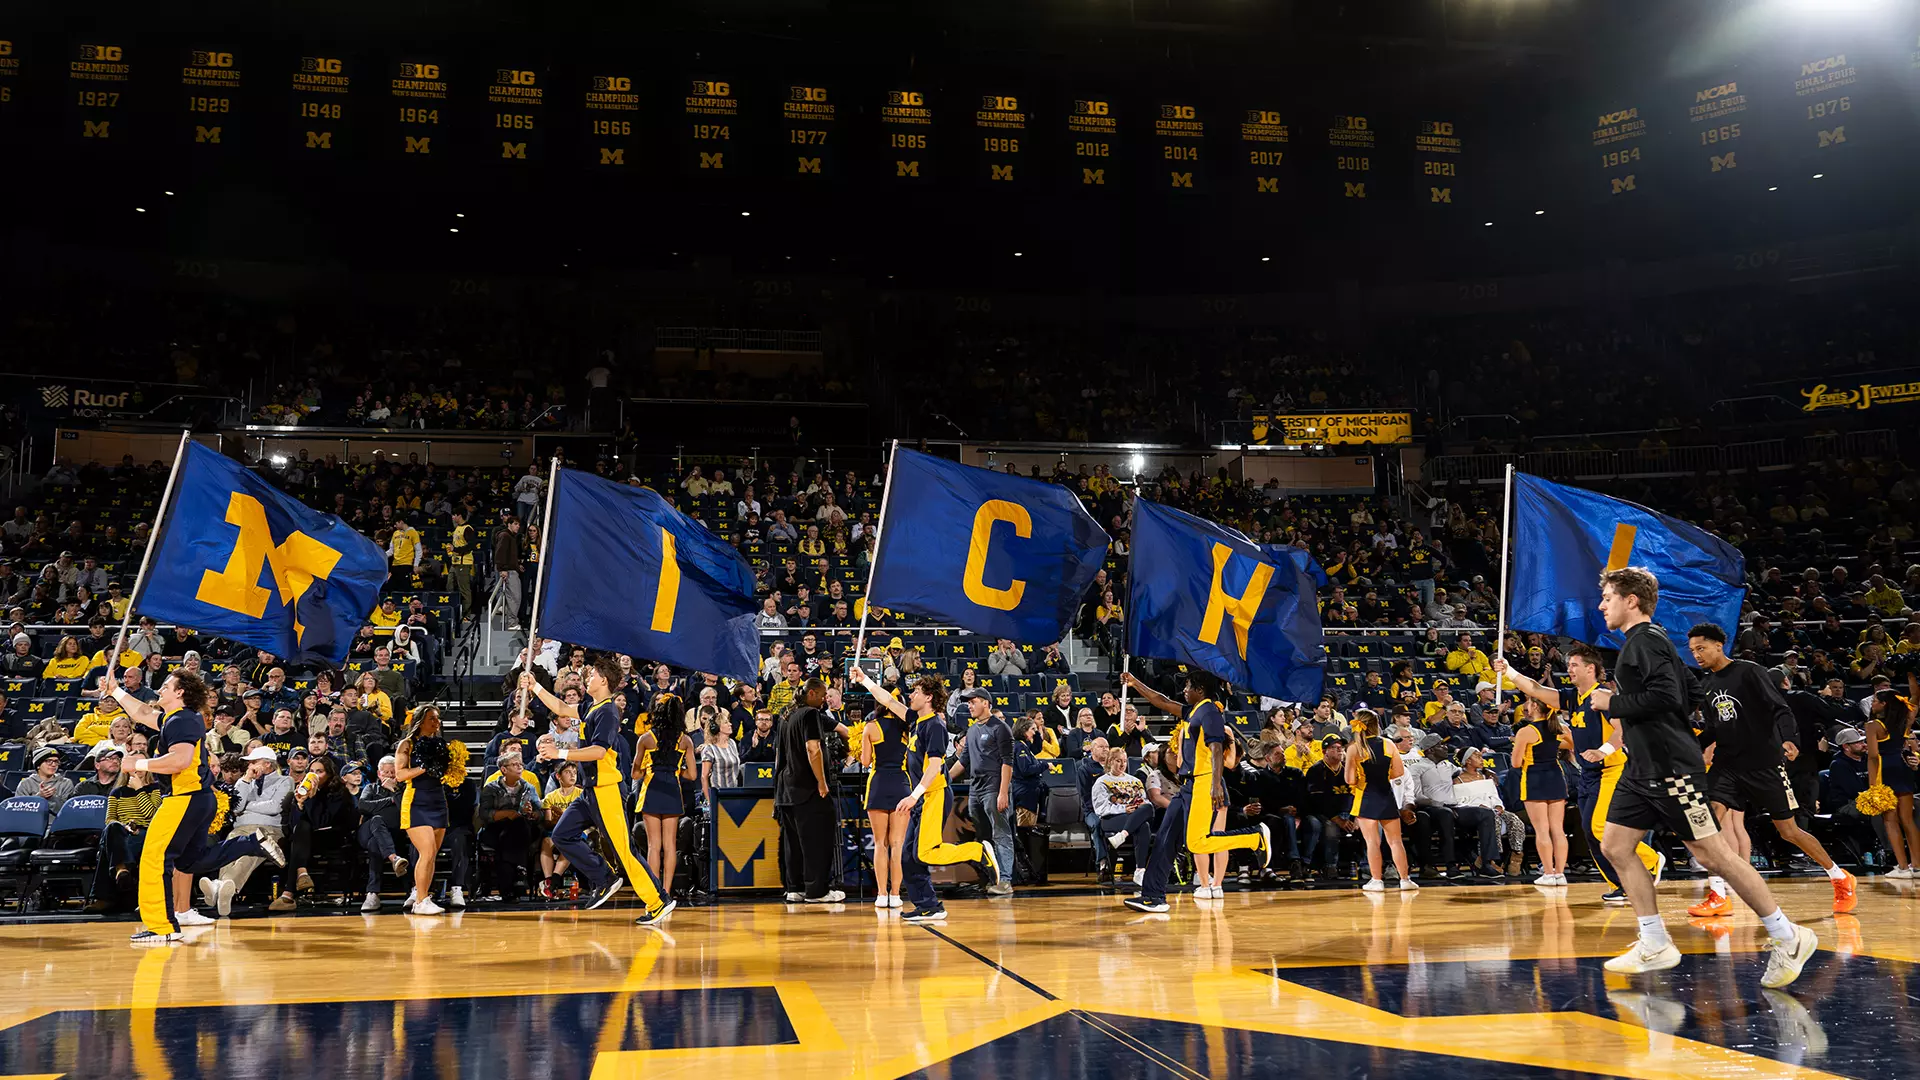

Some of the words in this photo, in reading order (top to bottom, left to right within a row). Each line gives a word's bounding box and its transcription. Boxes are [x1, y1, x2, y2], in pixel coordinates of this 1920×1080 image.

[70, 61, 129, 73] CHAMPIONS
[183, 67, 241, 79] CHAMPIONS
[1801, 54, 1846, 76] NCAA
[292, 73, 349, 85] CHAMPIONS
[392, 79, 447, 91] CHAMPIONS
[1795, 73, 1825, 90] FINAL
[488, 85, 542, 97] CHAMPIONS
[586, 92, 639, 103] CHAMPIONS
[1696, 82, 1737, 102] NCAA
[77, 91, 120, 108] 1927
[189, 96, 230, 114] 1929
[685, 96, 737, 108] CHAMPIONS
[784, 101, 834, 113] CHAMPIONS
[301, 102, 341, 120] 1948
[399, 107, 439, 125] 1964
[882, 106, 931, 117] CHAMPIONS
[1689, 101, 1718, 116] FINAL
[1807, 97, 1851, 119] 1976
[495, 113, 534, 130] 1965
[976, 111, 1025, 122] CHAMPIONS
[1069, 115, 1117, 126] CHAMPIONS
[1598, 108, 1637, 126] NCAA
[83, 120, 110, 139] M
[593, 120, 631, 136] 1966
[692, 124, 730, 140] 1974
[1156, 119, 1204, 131] CHAMPIONS
[1592, 126, 1620, 140] FINAL
[195, 126, 221, 144] M
[306, 131, 331, 149] M
[790, 129, 827, 145] 1977
[891, 133, 926, 150] 1985
[1416, 136, 1461, 145] CHAMPIONS
[1701, 124, 1741, 146] 1965
[1818, 126, 1846, 148] M
[405, 136, 431, 154] M
[502, 141, 527, 159] M
[984, 137, 1019, 153] 1986
[1076, 142, 1109, 157] 2012
[1164, 145, 1198, 161] 2014
[600, 147, 624, 165] M
[700, 152, 724, 168] M
[1249, 151, 1283, 166] 2017
[1337, 156, 1369, 171] 2018
[1602, 147, 1641, 168] 1964
[1710, 152, 1737, 172] M
[798, 156, 821, 173] M
[897, 160, 920, 177] M
[991, 164, 1014, 181] M
[1424, 162, 1455, 176] 2021
[1083, 168, 1105, 185] M
[1171, 171, 1194, 188] M
[1611, 175, 1636, 194] M
[1257, 177, 1279, 193] M
[1344, 182, 1366, 199] M
[1431, 187, 1451, 204] M
[74, 389, 129, 408] Ruof
[1856, 381, 1920, 410] JEWELE
[1326, 416, 1343, 427] OF
[1346, 415, 1409, 426] MICHIGAN
[1282, 427, 1316, 438] REDIT
[1337, 427, 1378, 438] UNION
[963, 498, 1032, 611] C
[651, 527, 681, 634] I
[1197, 542, 1275, 662] H
[8, 683, 21, 691] M
[56, 683, 69, 691] M
[29, 704, 43, 712] M
[76, 702, 90, 711] M
[1236, 716, 1248, 724] M
[1571, 712, 1586, 728] M
[1050, 764, 1063, 774] M
[1482, 758, 1495, 768] M
[758, 768, 772, 778] M
[14, 801, 41, 809] UMCU
